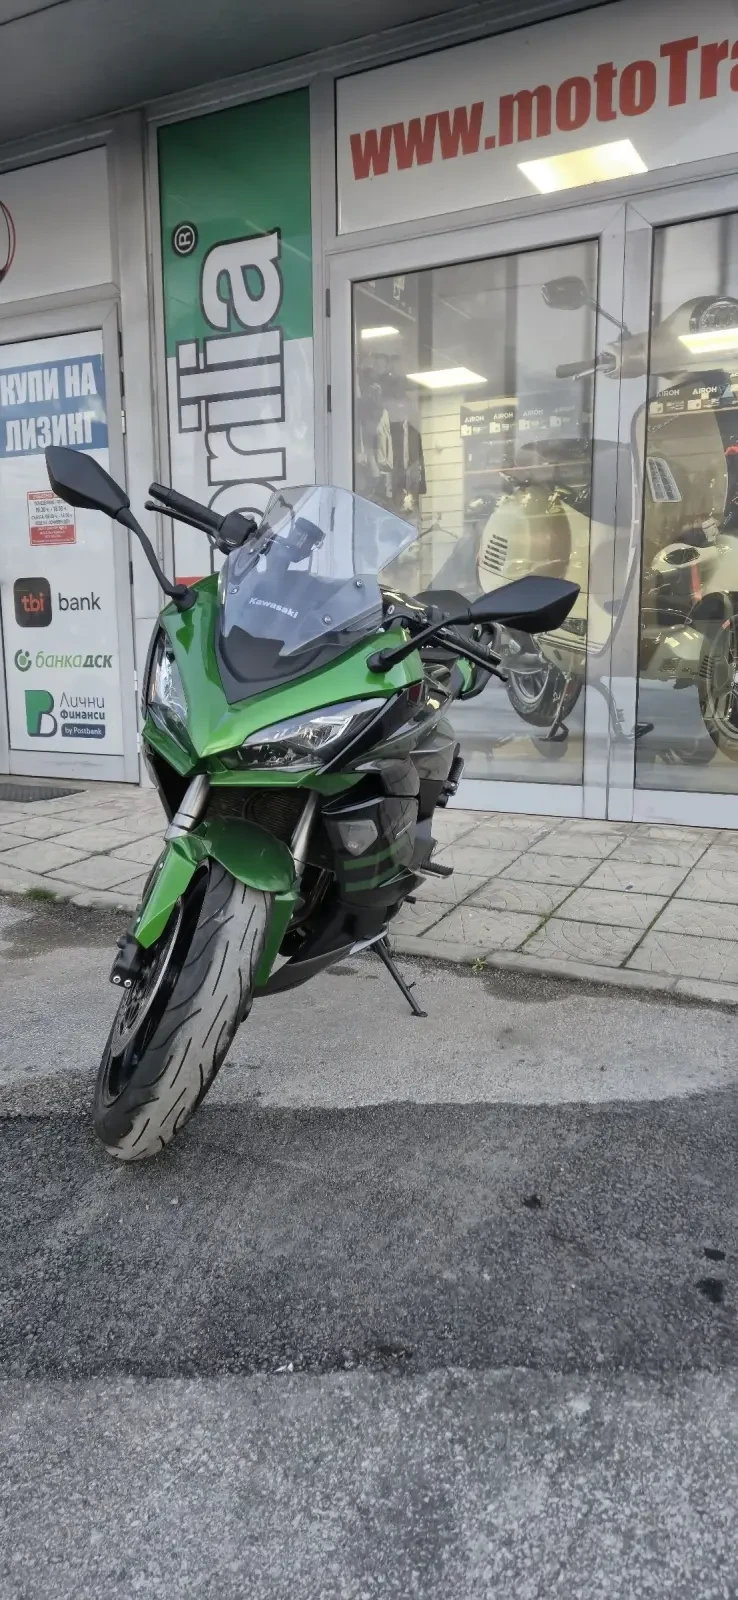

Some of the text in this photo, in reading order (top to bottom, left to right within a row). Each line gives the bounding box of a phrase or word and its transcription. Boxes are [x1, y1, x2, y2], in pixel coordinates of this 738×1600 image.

[350, 35, 738, 181] www.motoTr
[0, 362, 97, 406] КУПИ НА
[177, 228, 286, 574] prilia
[5, 410, 96, 452] ЛИЗИНГ
[21, 591, 101, 613] tbi bank
[248, 597, 299, 619] Kawasaki
[59, 691, 105, 709] Лични
[64, 726, 103, 736] by Postbank
